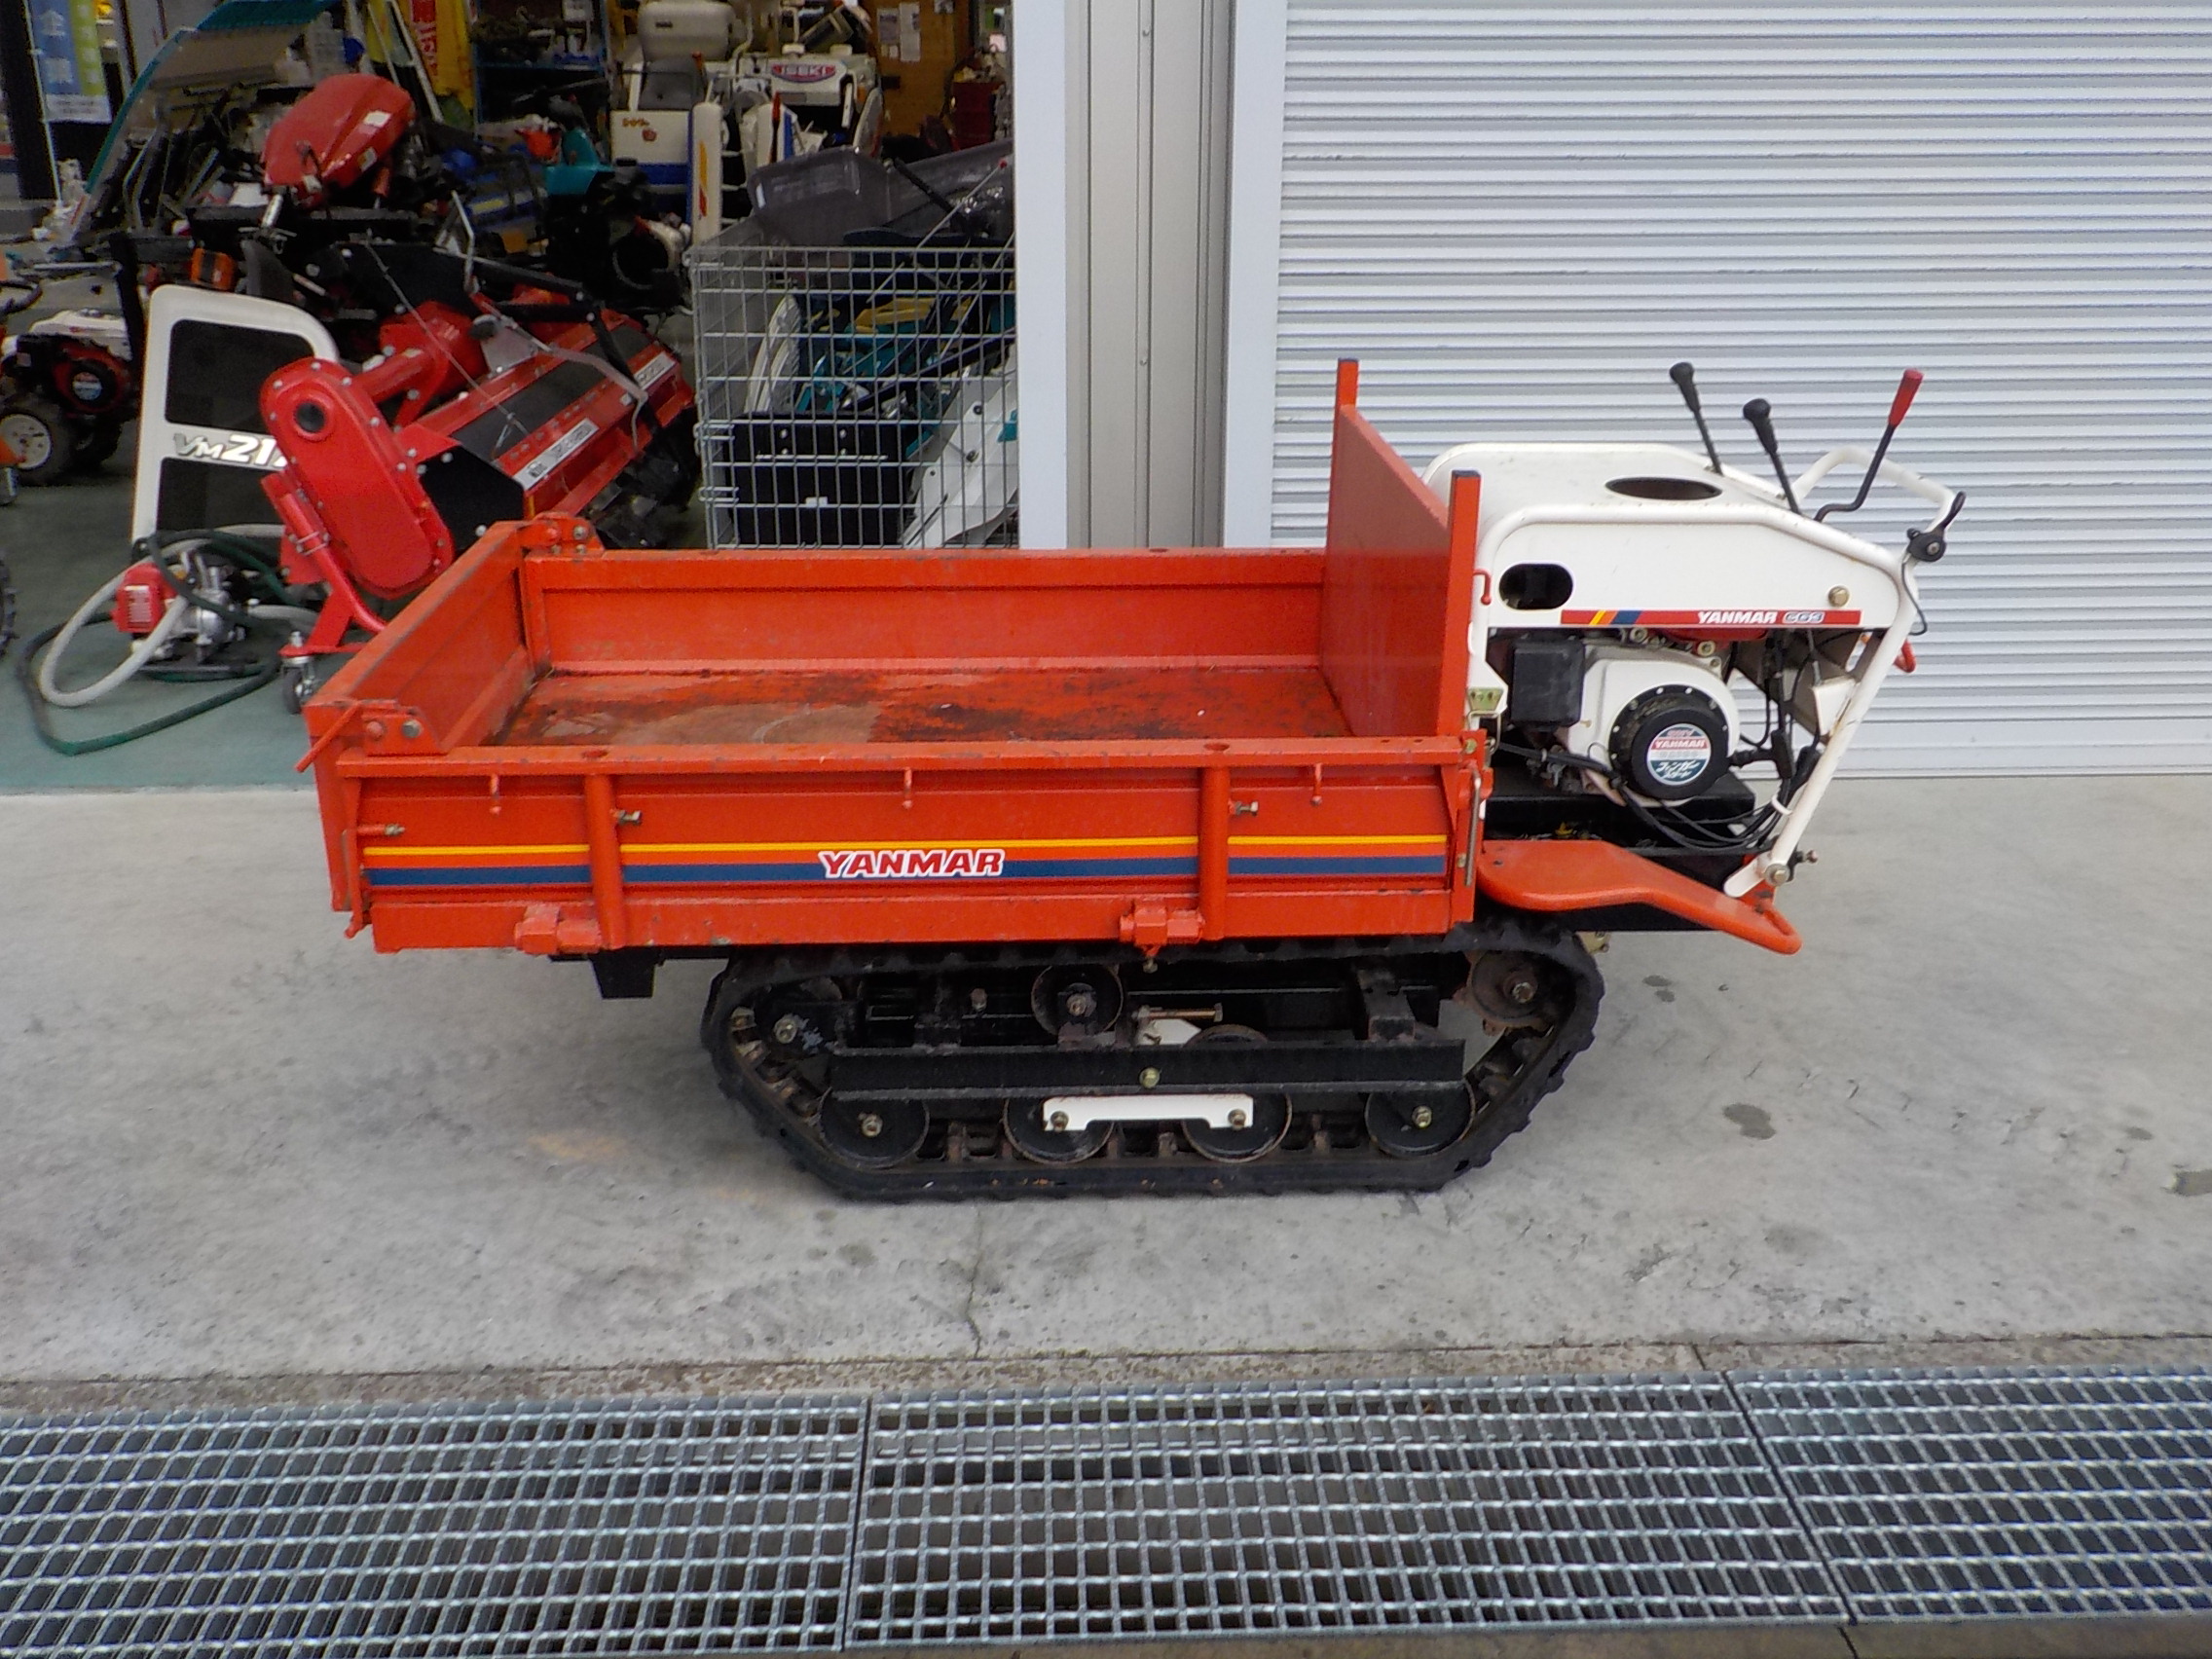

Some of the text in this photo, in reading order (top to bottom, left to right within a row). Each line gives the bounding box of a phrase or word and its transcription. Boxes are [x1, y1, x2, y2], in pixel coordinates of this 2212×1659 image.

[1697, 610, 1779, 624] YANMAR
[1655, 739, 1706, 749] YANMAR
[818, 849, 1005, 878] YANMAR
